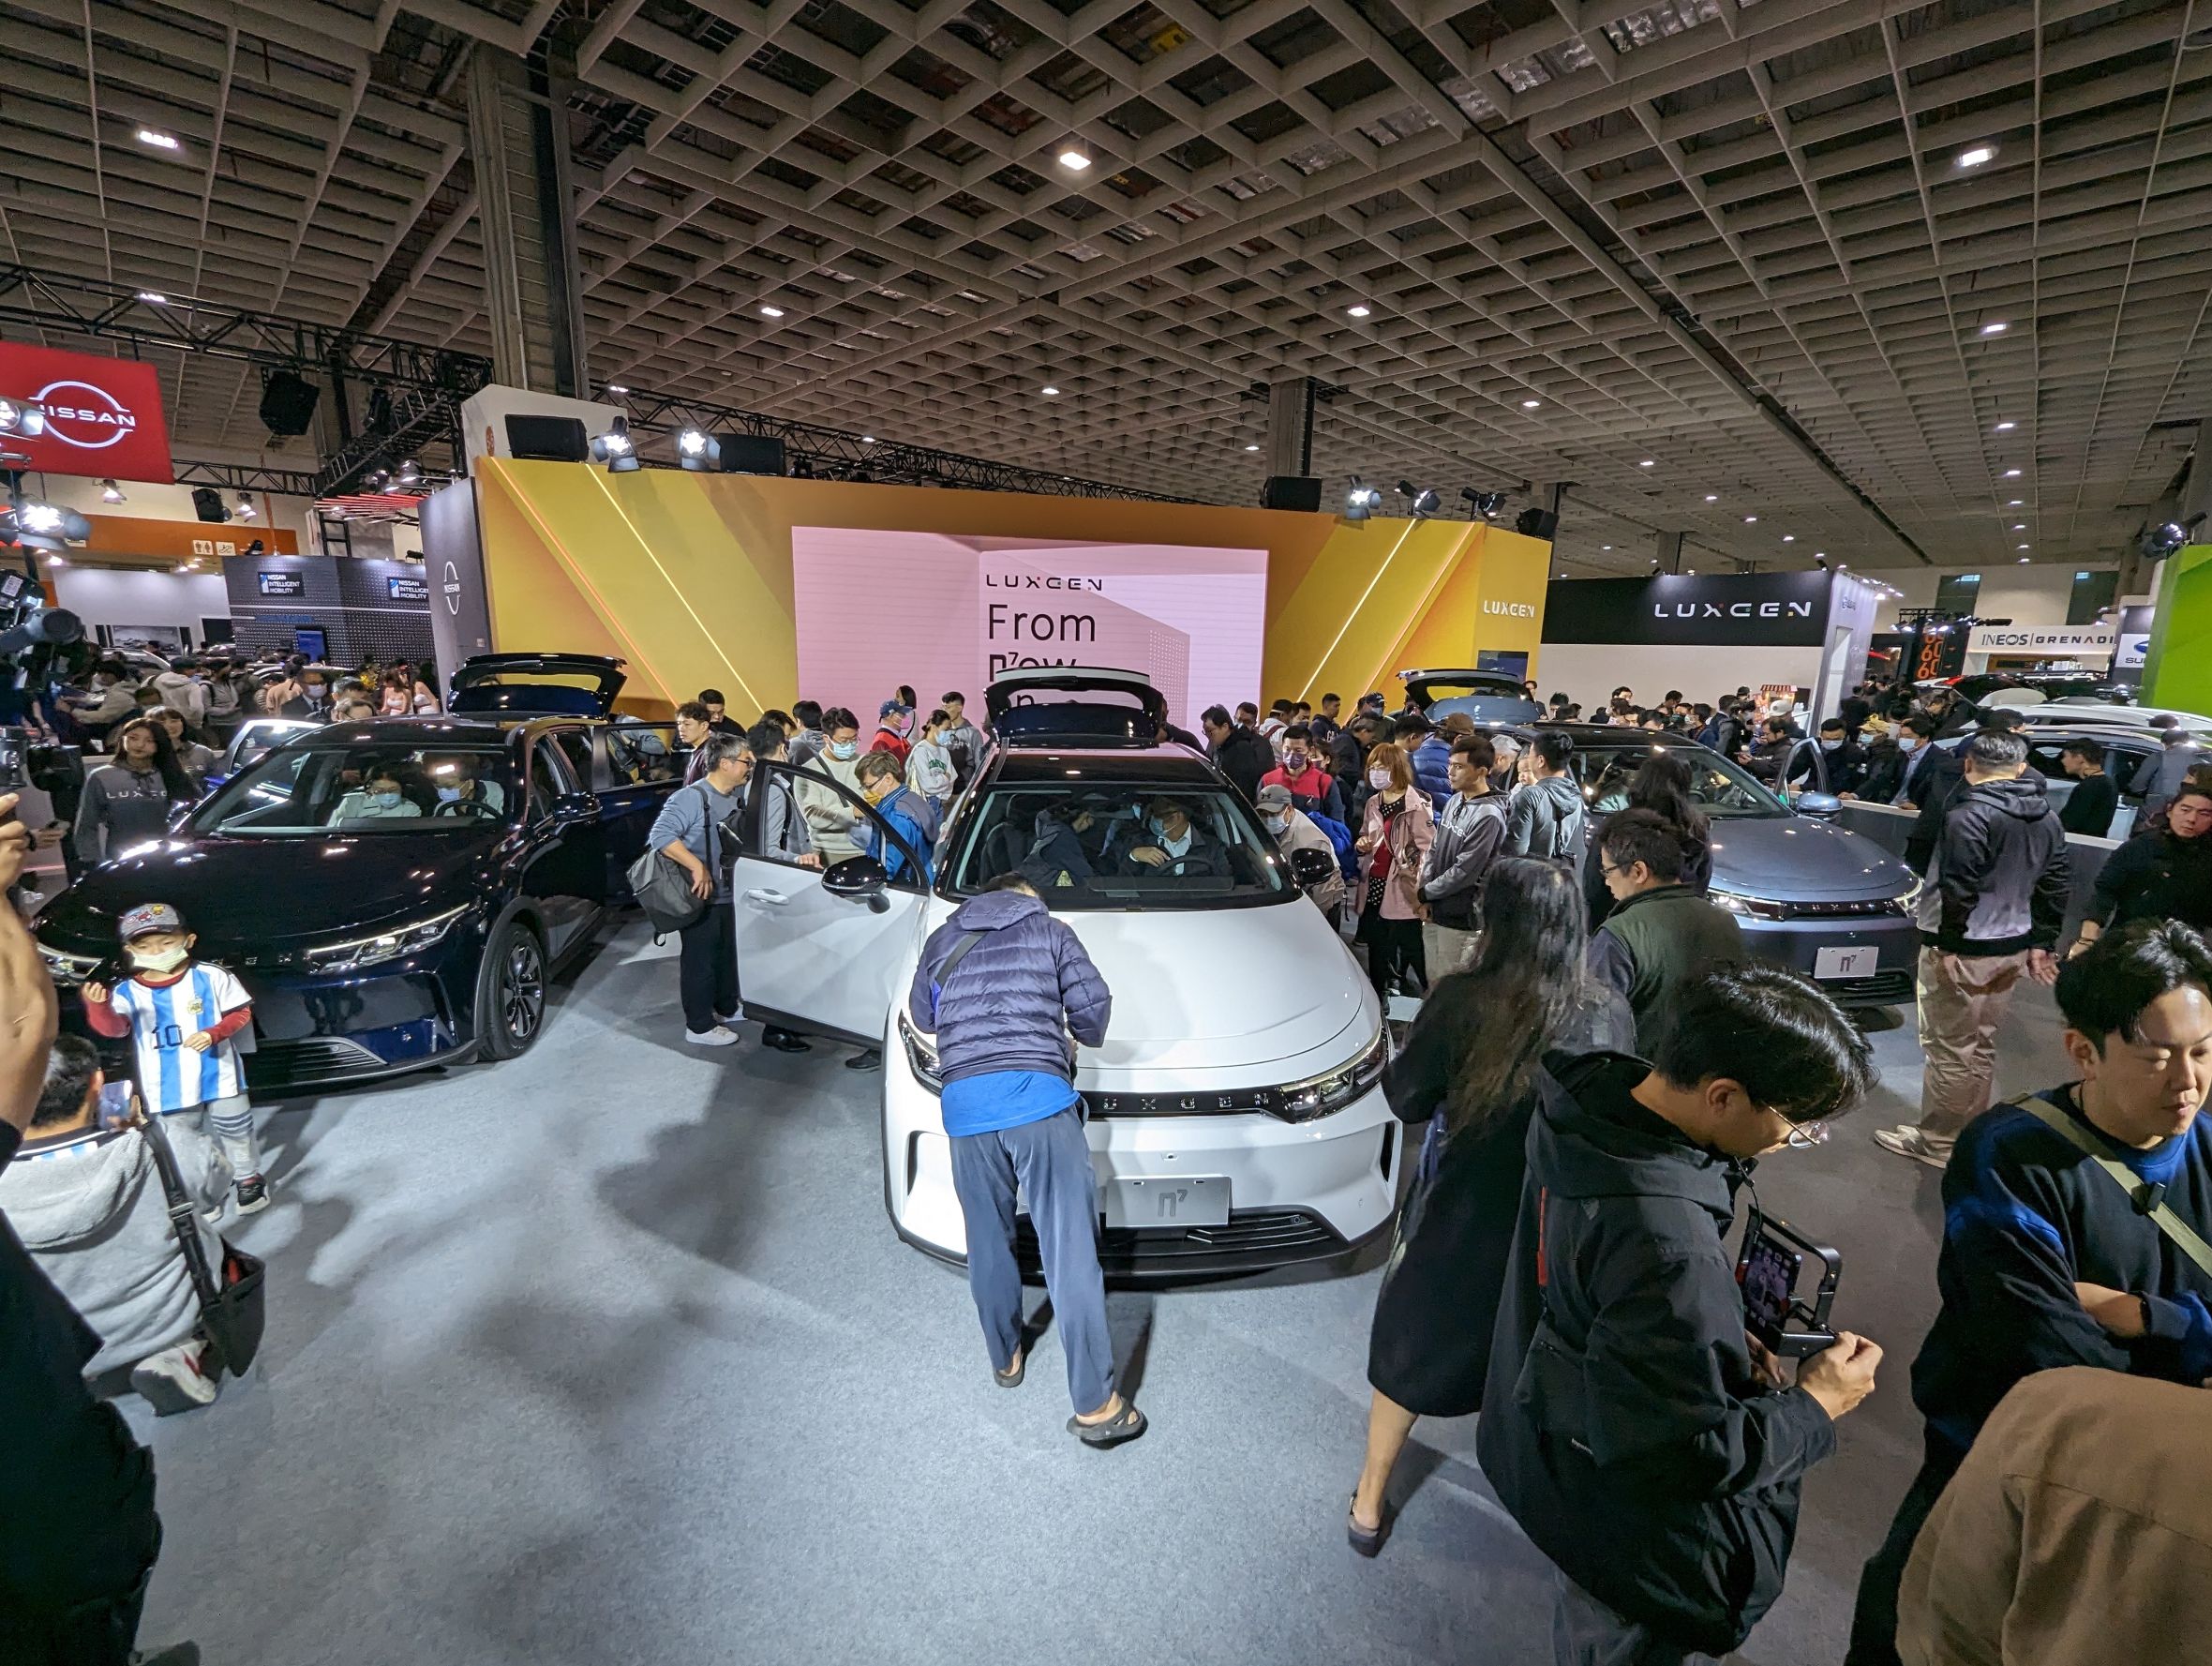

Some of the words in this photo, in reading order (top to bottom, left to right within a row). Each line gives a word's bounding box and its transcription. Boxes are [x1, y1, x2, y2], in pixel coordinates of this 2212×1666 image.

[989, 604, 1096, 641] From
[1981, 634, 2029, 646] INEOS
[152, 1024, 183, 1049] 10
